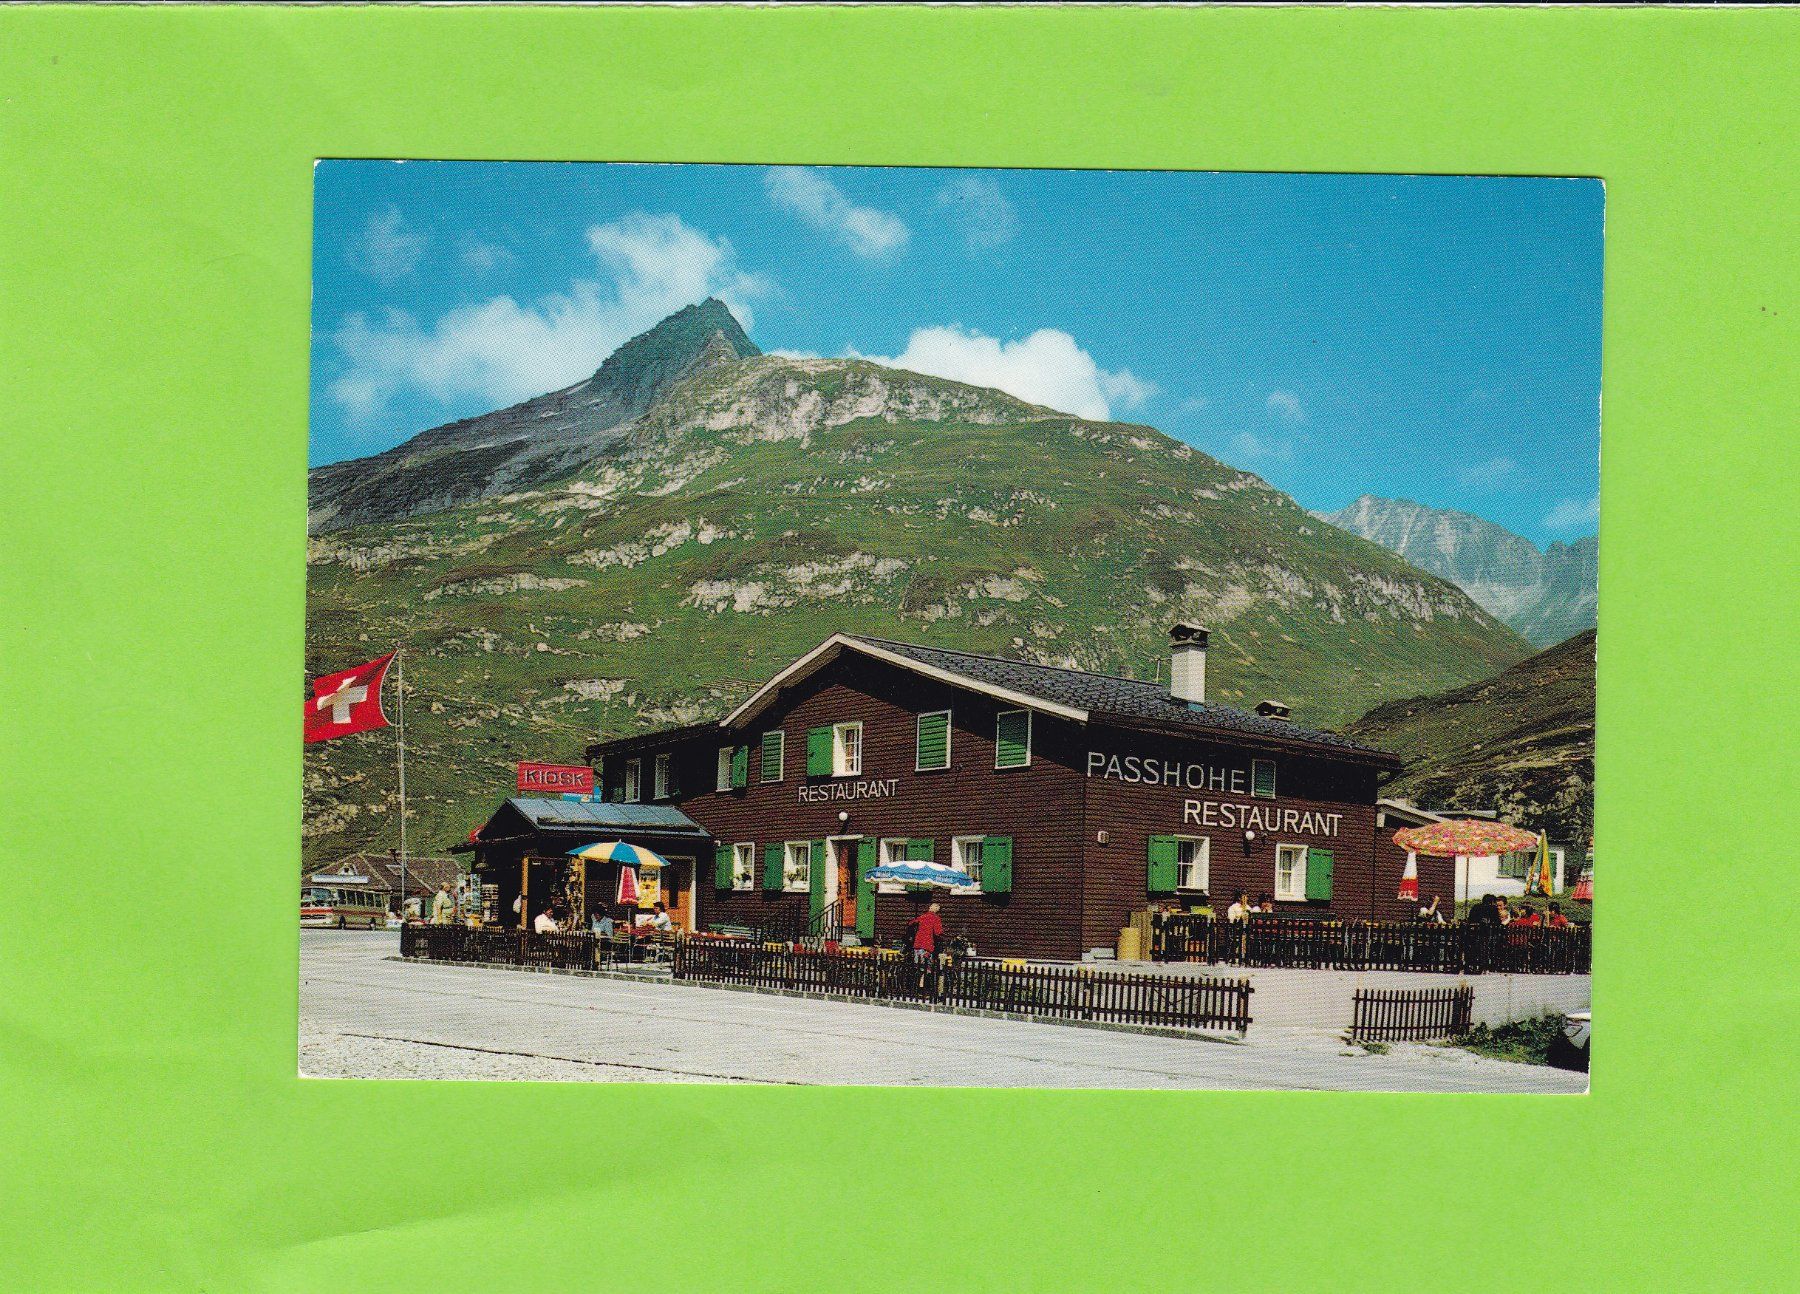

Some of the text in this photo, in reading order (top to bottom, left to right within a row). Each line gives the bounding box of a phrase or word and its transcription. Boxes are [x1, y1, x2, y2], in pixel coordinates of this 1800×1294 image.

[525, 769, 585, 787] KIOSK
[798, 779, 900, 803] RESTAURANT
[1184, 799, 1343, 837] RESTAURANT
